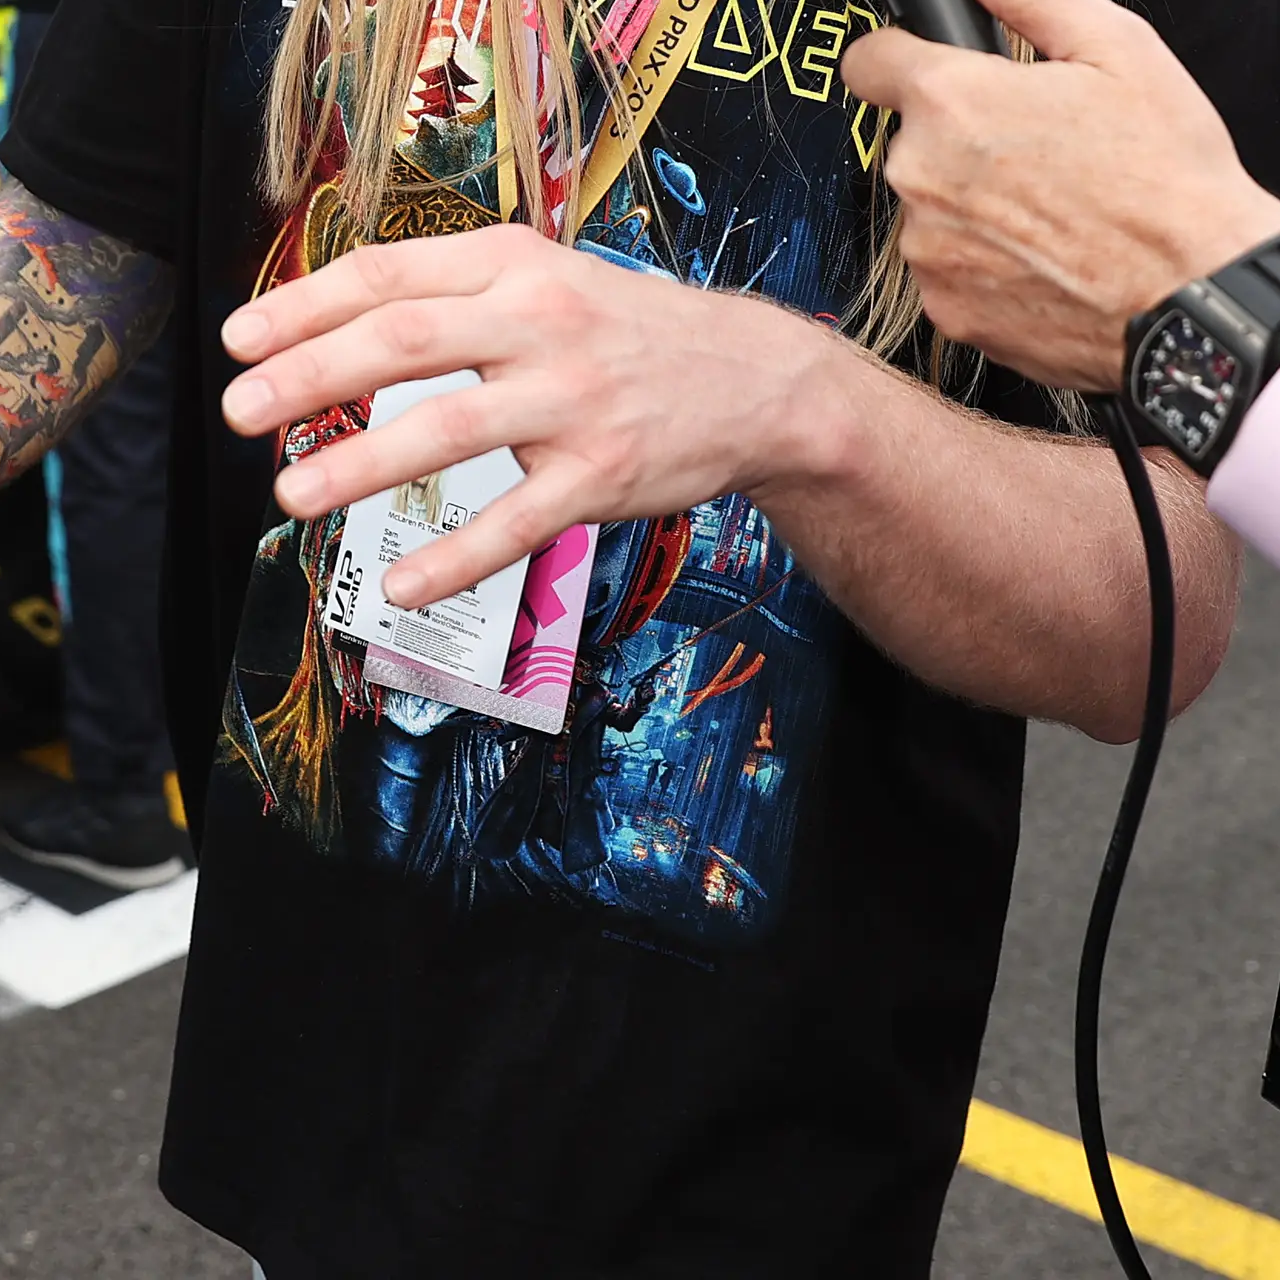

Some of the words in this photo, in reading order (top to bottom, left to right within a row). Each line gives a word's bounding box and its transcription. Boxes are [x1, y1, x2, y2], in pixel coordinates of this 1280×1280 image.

[643, 15, 688, 78] PRIX
[609, 76, 654, 140] 203
[381, 535, 402, 549] Ryder
[383, 527, 399, 539] Sam
[387, 510, 417, 528] McLaren
[417, 521, 426, 531] F1
[427, 524, 446, 537] Team
[379, 544, 405, 559] Sunday
[329, 549, 354, 623] VIP
[343, 566, 364, 628] GRID
